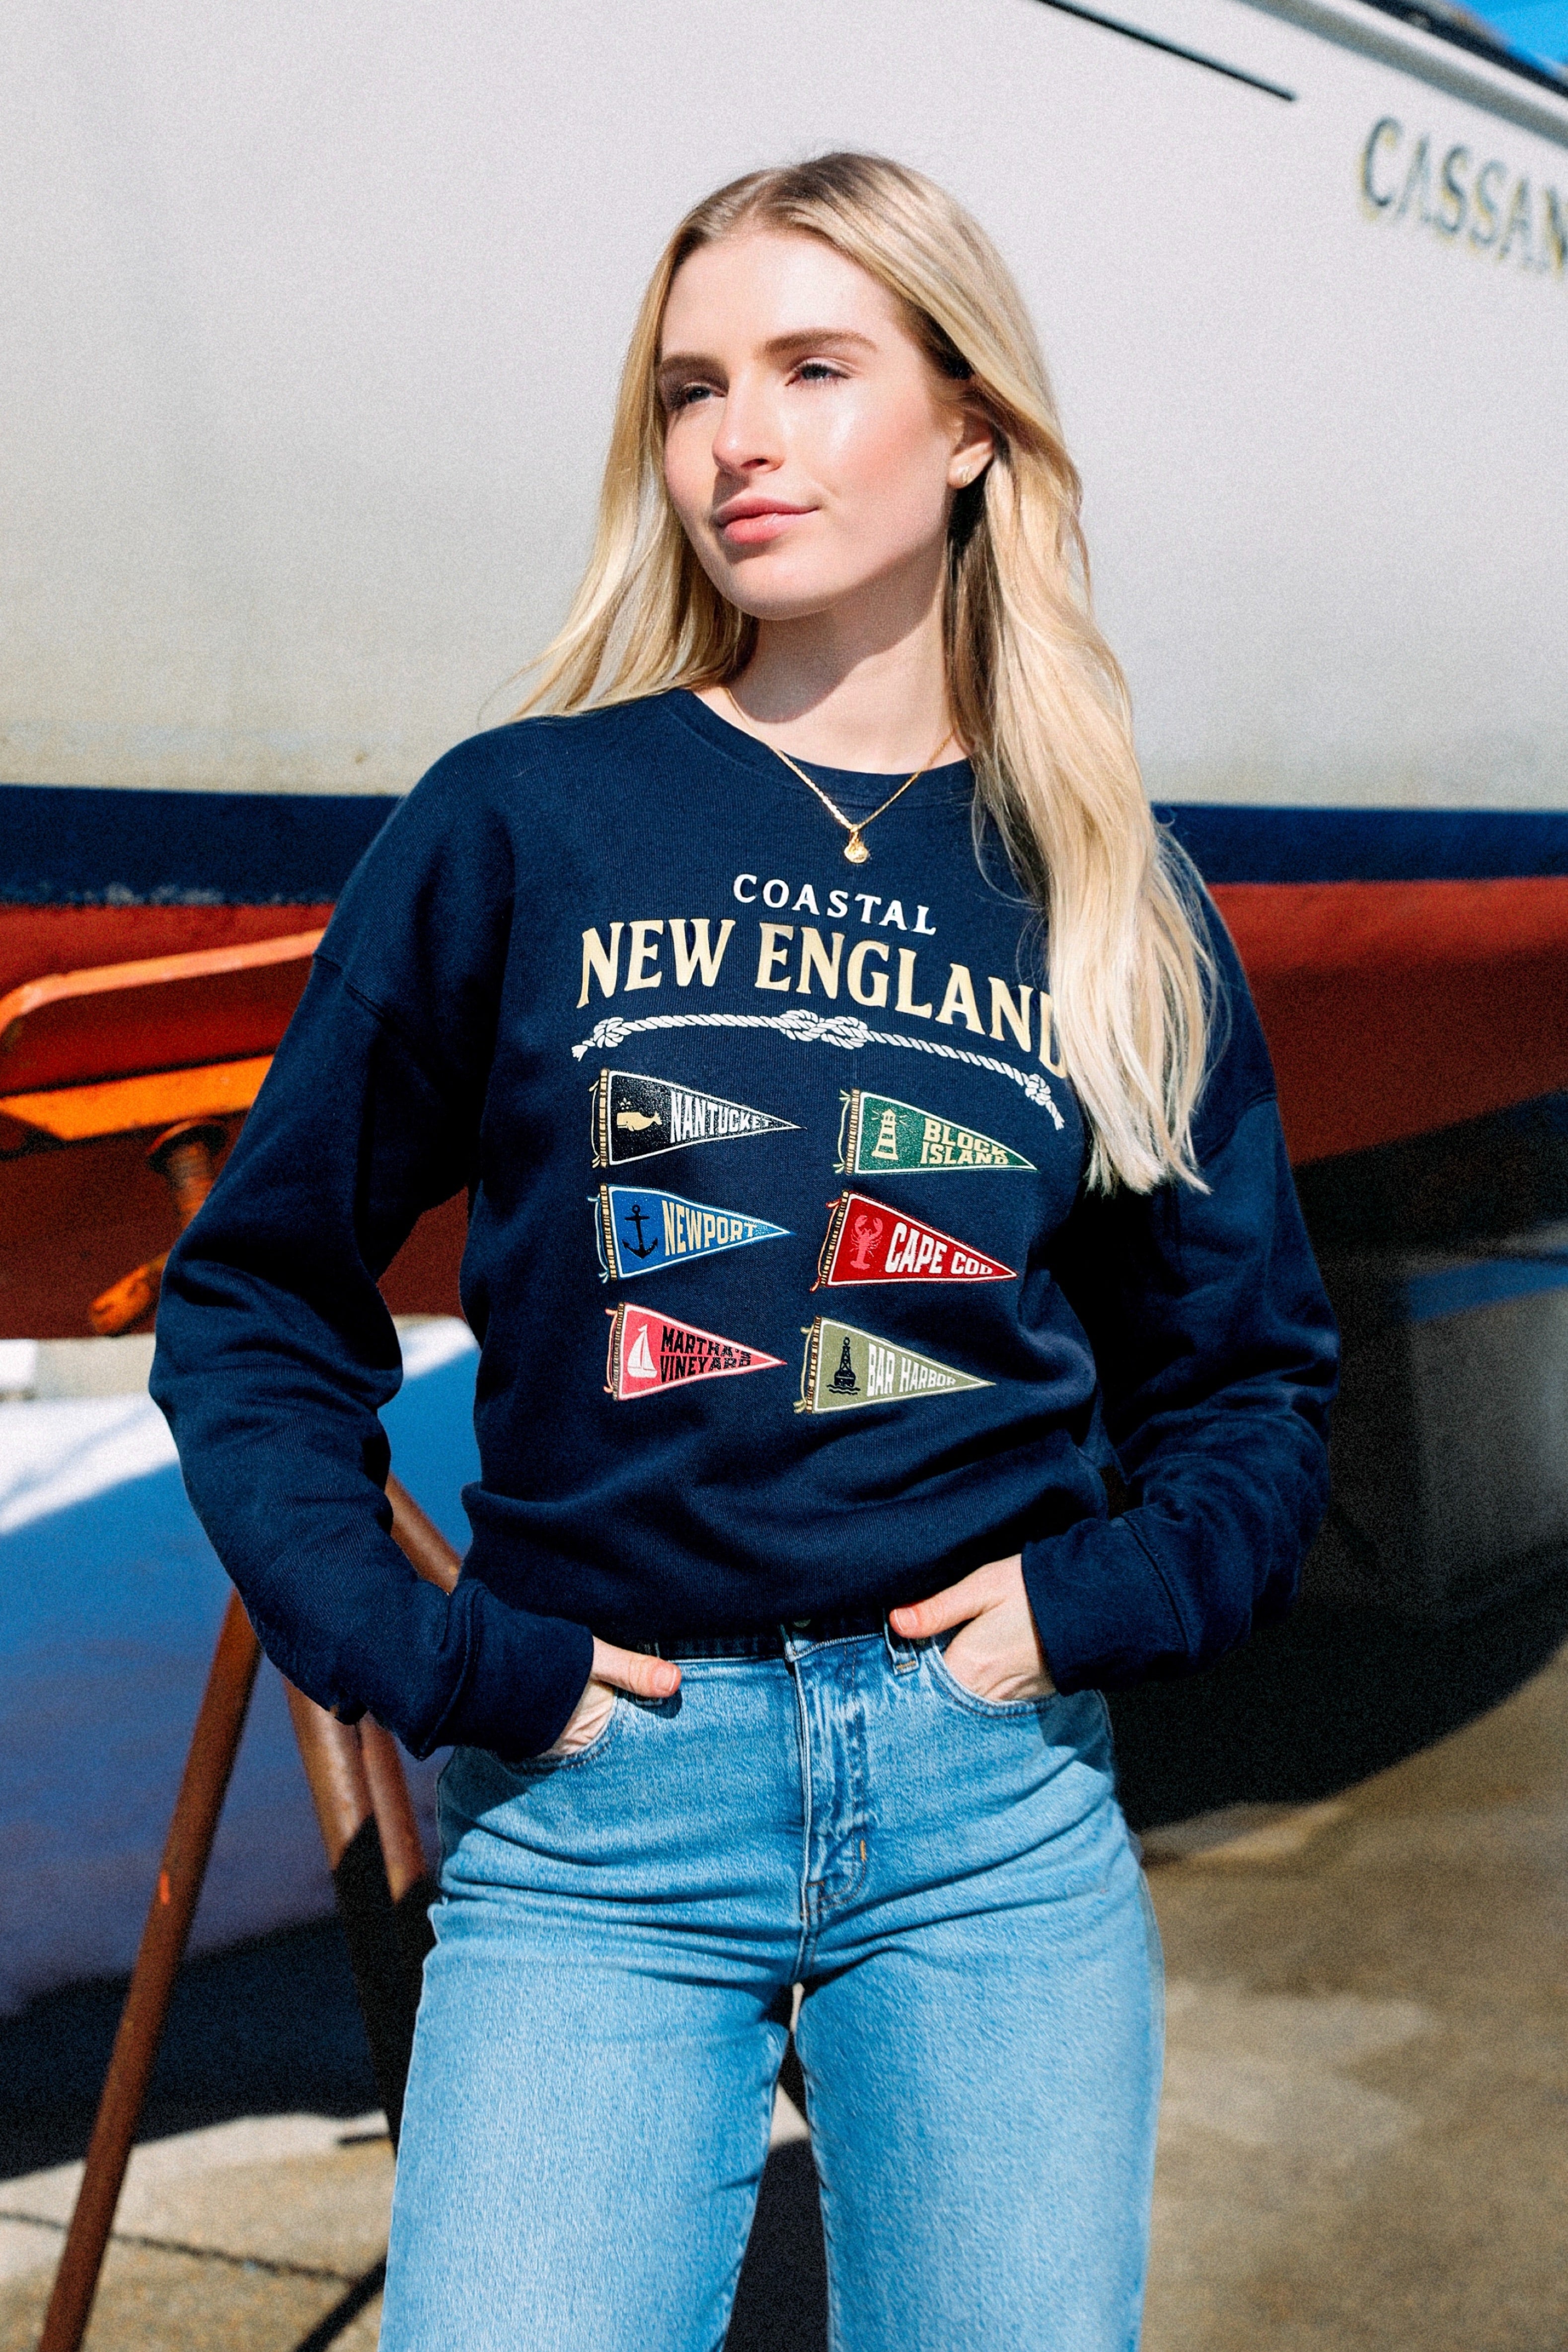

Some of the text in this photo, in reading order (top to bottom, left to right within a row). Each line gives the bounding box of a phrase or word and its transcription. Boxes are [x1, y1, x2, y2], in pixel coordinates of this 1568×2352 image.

[733, 873, 937, 935] COASTAL
[576, 919, 736, 1008] NEW
[670, 1091, 771, 1143] NANTUCKET
[923, 1118, 1007, 1159] BLOCK
[920, 1141, 1009, 1164] ISLAND
[662, 1200, 757, 1256] NEWPORT
[885, 1222, 993, 1275] CAPE COD
[661, 1325, 751, 1359] MARTHA'S
[660, 1355, 751, 1382] VINEYARD
[867, 1343, 956, 1397] BAR HARBOR
